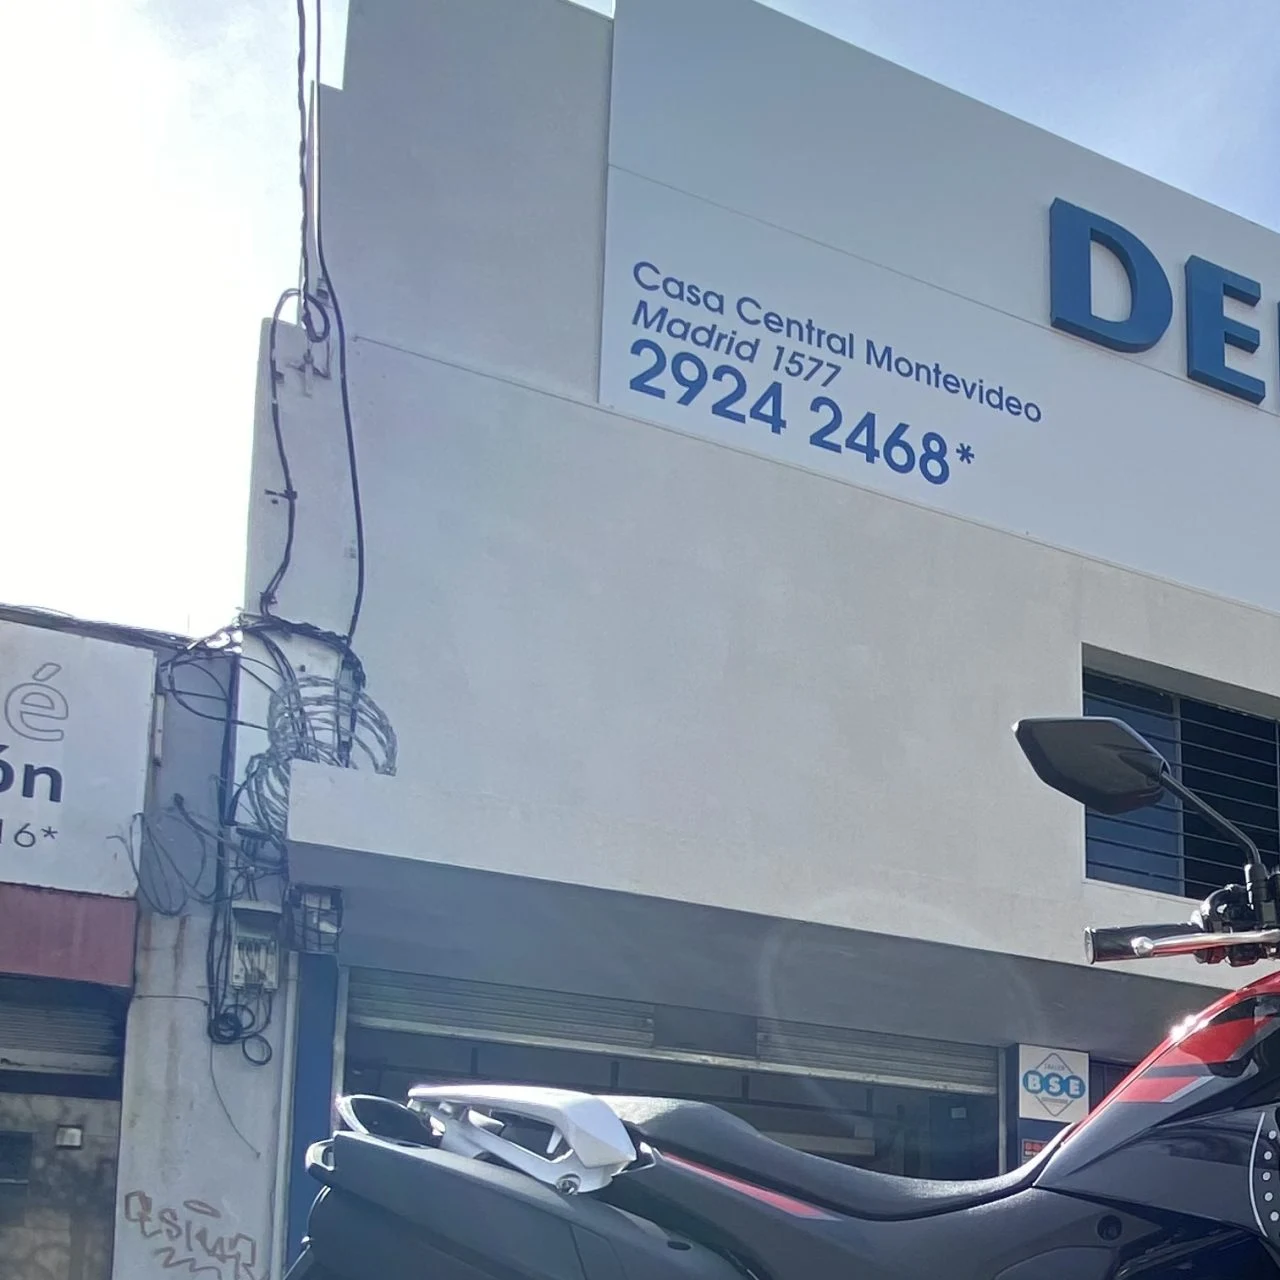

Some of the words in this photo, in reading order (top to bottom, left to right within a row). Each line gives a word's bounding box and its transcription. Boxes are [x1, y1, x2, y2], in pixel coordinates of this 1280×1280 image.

[628, 338, 787, 436] 2924
[631, 300, 761, 364] Madrid
[773, 345, 842, 388] 1577
[632, 261, 725, 316] Casa
[735, 297, 854, 360] Central
[865, 339, 1043, 423] Montevideo
[1026, 1073, 1082, 1096] BSE
